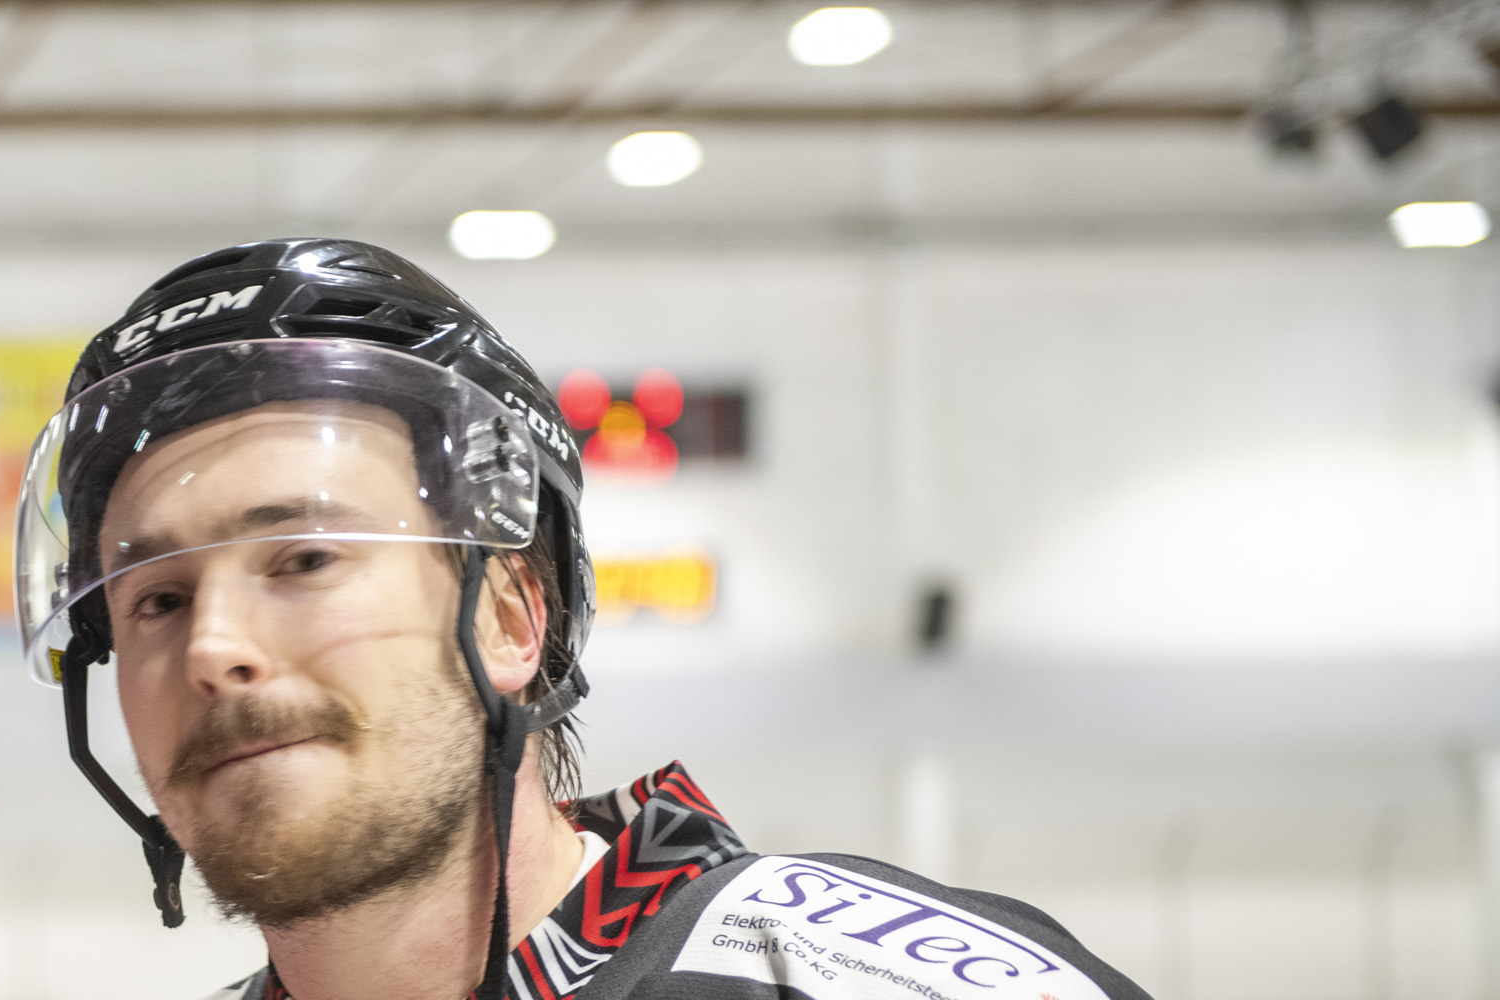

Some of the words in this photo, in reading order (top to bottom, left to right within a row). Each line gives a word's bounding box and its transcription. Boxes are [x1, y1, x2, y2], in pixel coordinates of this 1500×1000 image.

[113, 285, 264, 353] CCM
[711, 934, 769, 955] GmbH
[771, 937, 779, 953] &
[721, 913, 789, 929] Elektro-
[793, 931, 827, 955] und
[742, 863, 1061, 988] SiTec
